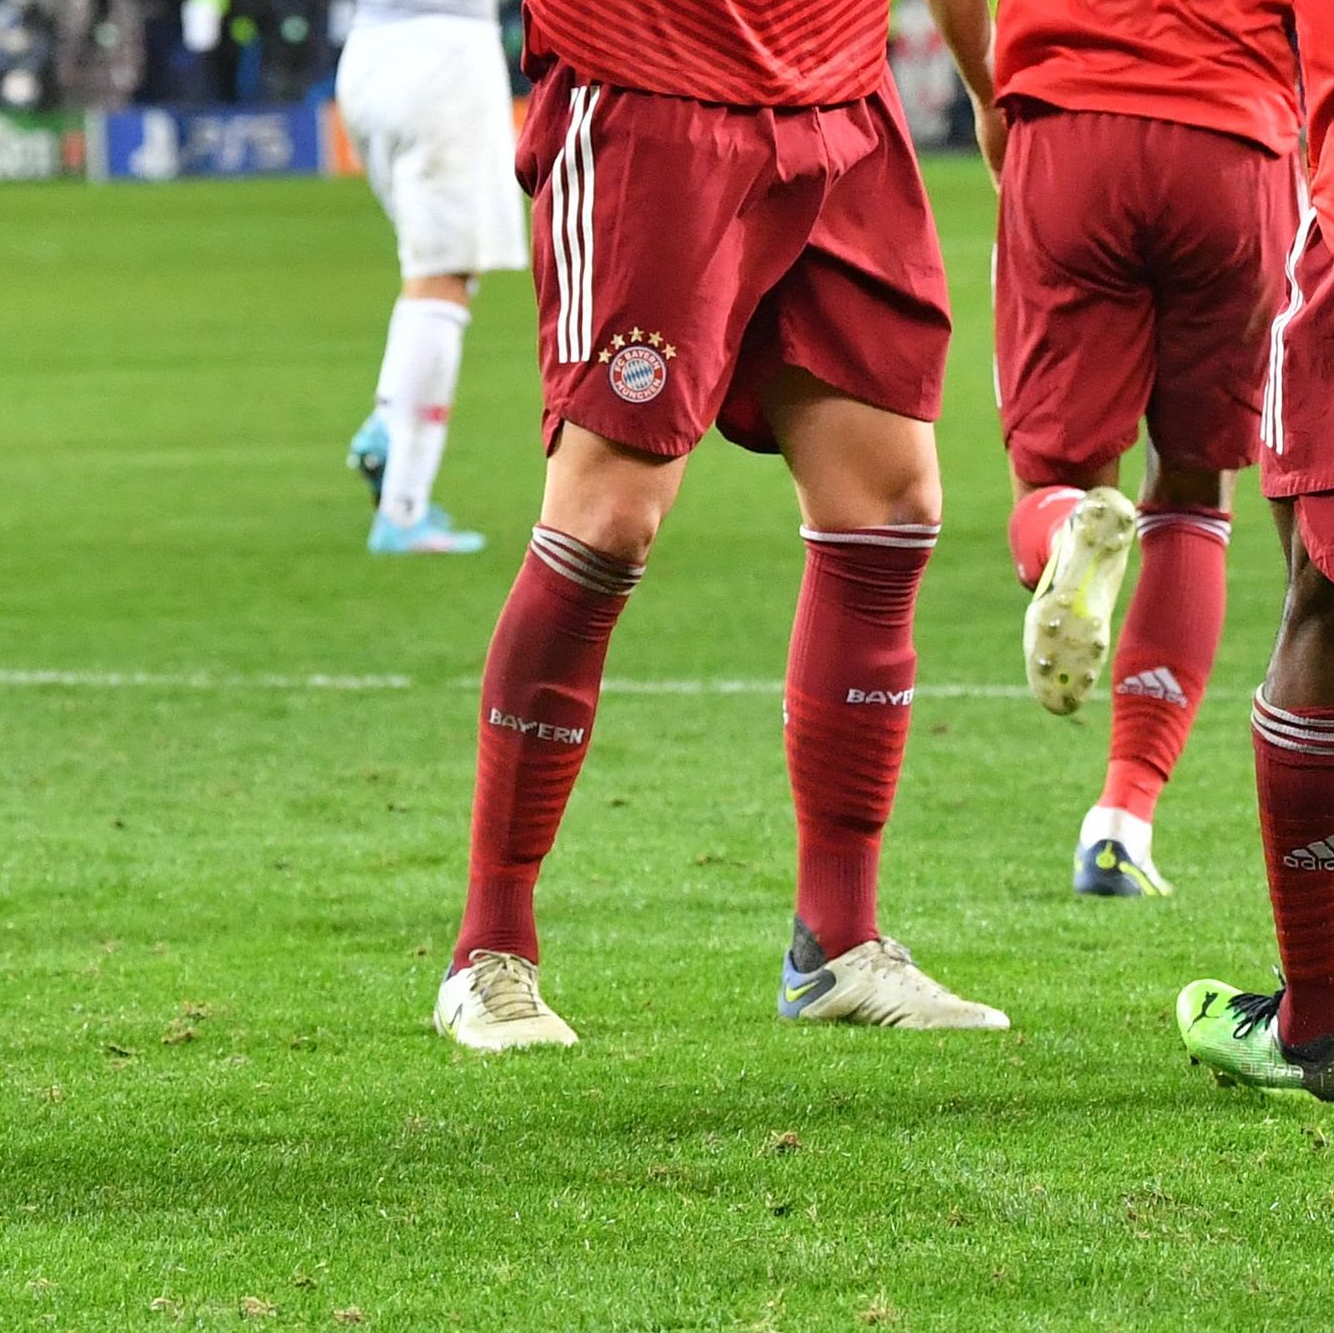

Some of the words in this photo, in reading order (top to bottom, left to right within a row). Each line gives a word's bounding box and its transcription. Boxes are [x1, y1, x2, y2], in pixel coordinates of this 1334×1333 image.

[624, 350, 661, 369] BAYERN
[1115, 683, 1187, 709] adidas
[489, 708, 584, 744] BAYERN
